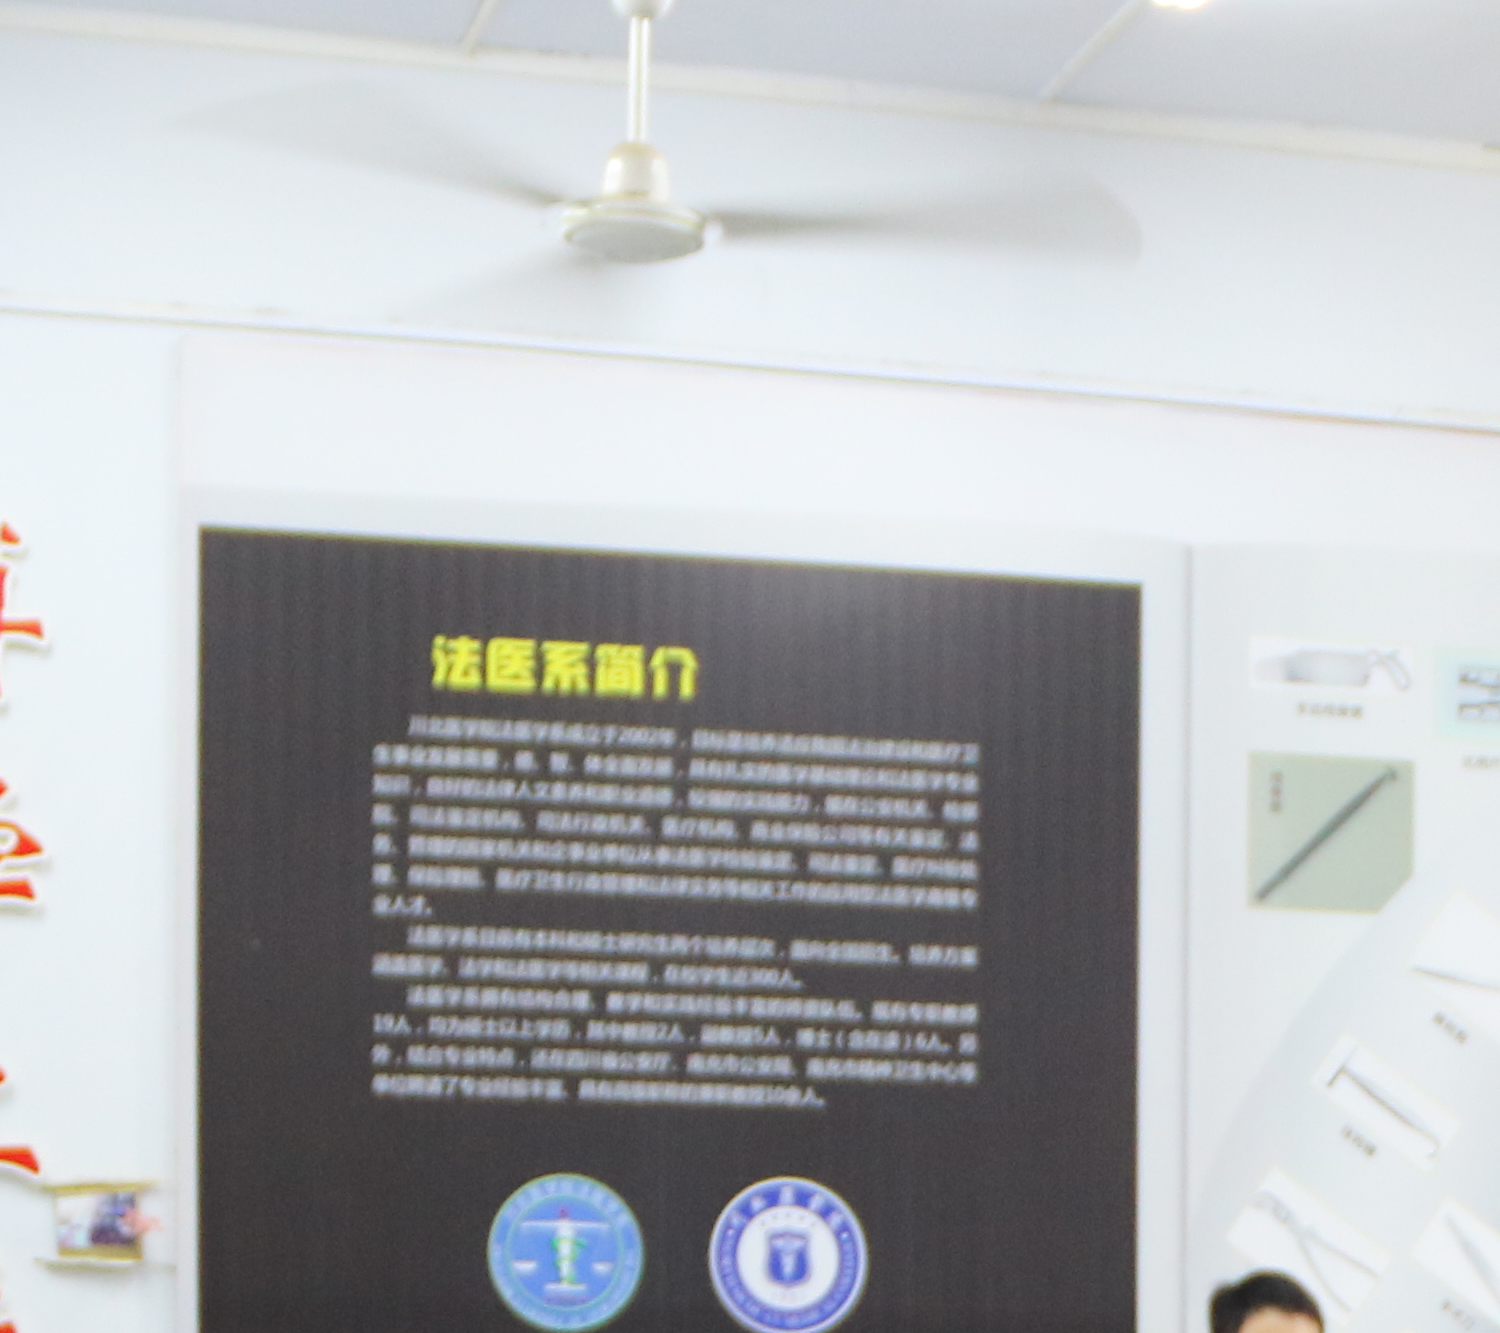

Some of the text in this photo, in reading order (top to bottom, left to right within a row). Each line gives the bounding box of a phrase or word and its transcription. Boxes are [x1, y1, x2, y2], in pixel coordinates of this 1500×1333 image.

[430, 631, 700, 701] 法医系简介
